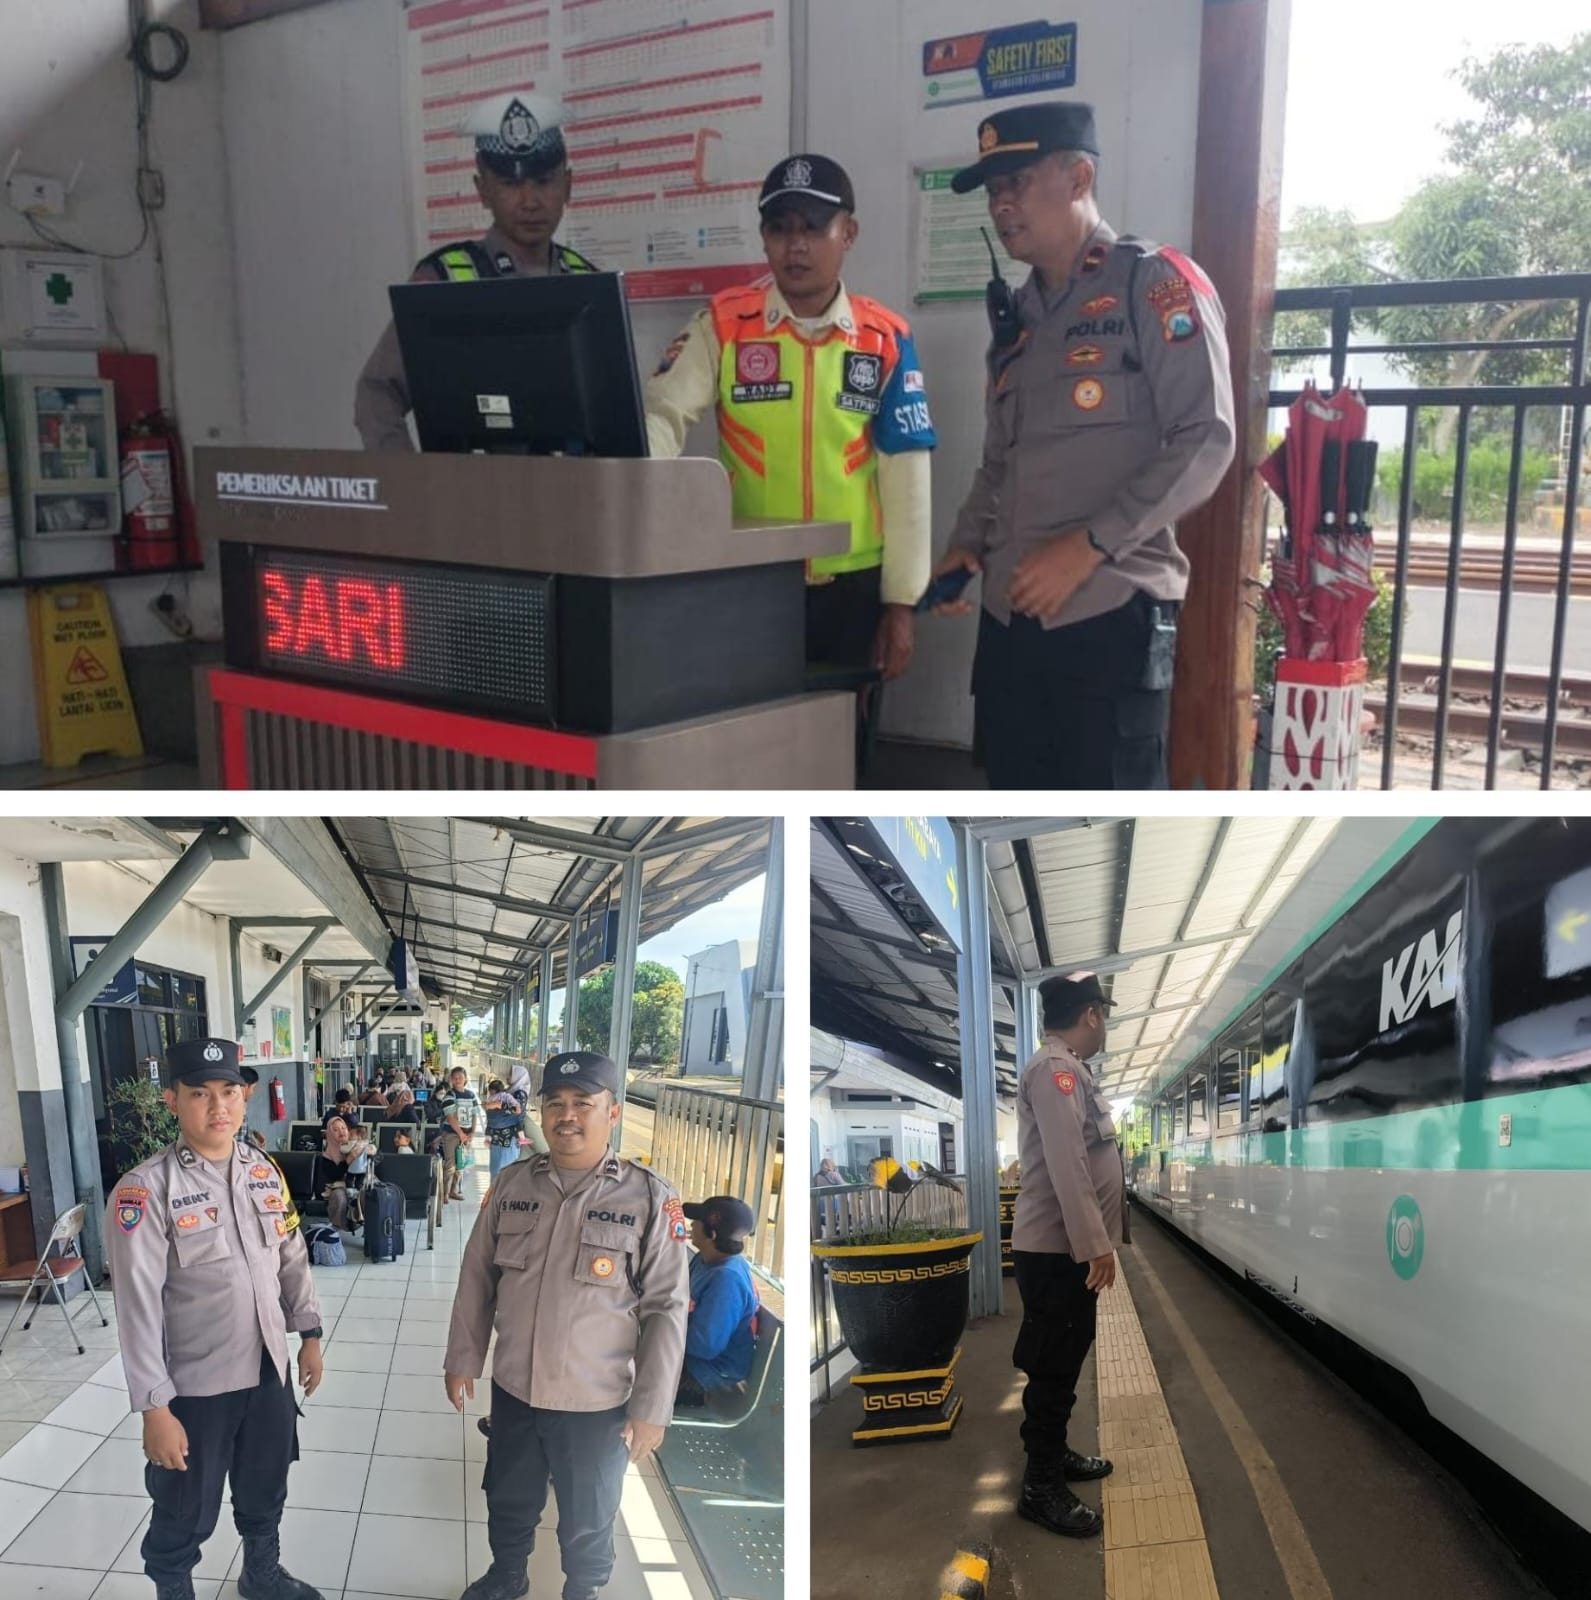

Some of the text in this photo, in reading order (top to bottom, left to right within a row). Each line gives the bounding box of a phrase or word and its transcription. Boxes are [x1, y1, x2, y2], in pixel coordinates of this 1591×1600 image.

[986, 34, 1073, 75] SAFETY FIRST
[1064, 319, 1125, 341] POLRI
[216, 472, 379, 501] PEMERIKSAAN TIKET
[248, 1181, 279, 1191] POLRI
[171, 1192, 211, 1209] DENY
[509, 1200, 529, 1211] HADI
[587, 1210, 636, 1227] POLRI
